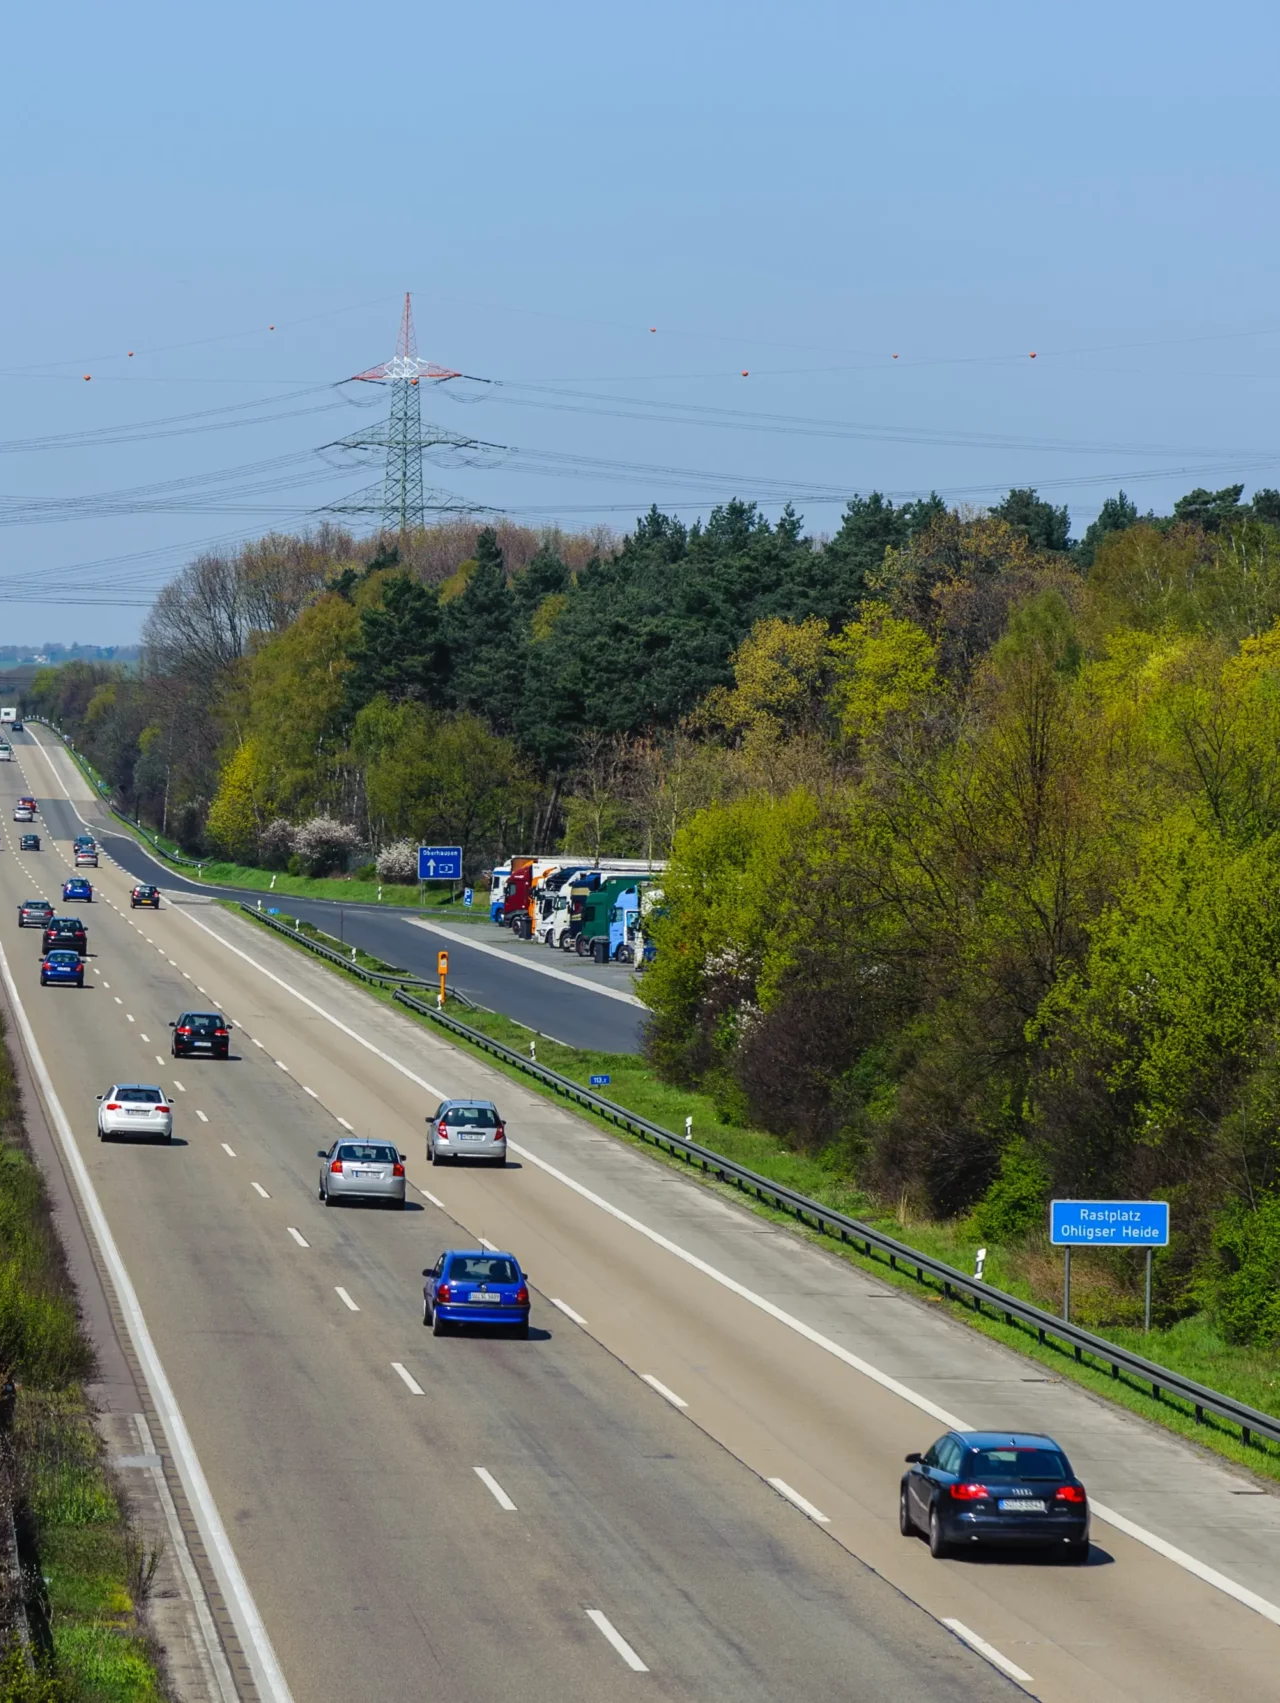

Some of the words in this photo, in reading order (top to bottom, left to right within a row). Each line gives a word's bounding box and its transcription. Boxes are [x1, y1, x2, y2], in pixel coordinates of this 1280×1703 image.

[1080, 1208, 1141, 1223] Rastplatz
[1061, 1225, 1116, 1239] Ohligser
[1122, 1226, 1159, 1237] Heide
